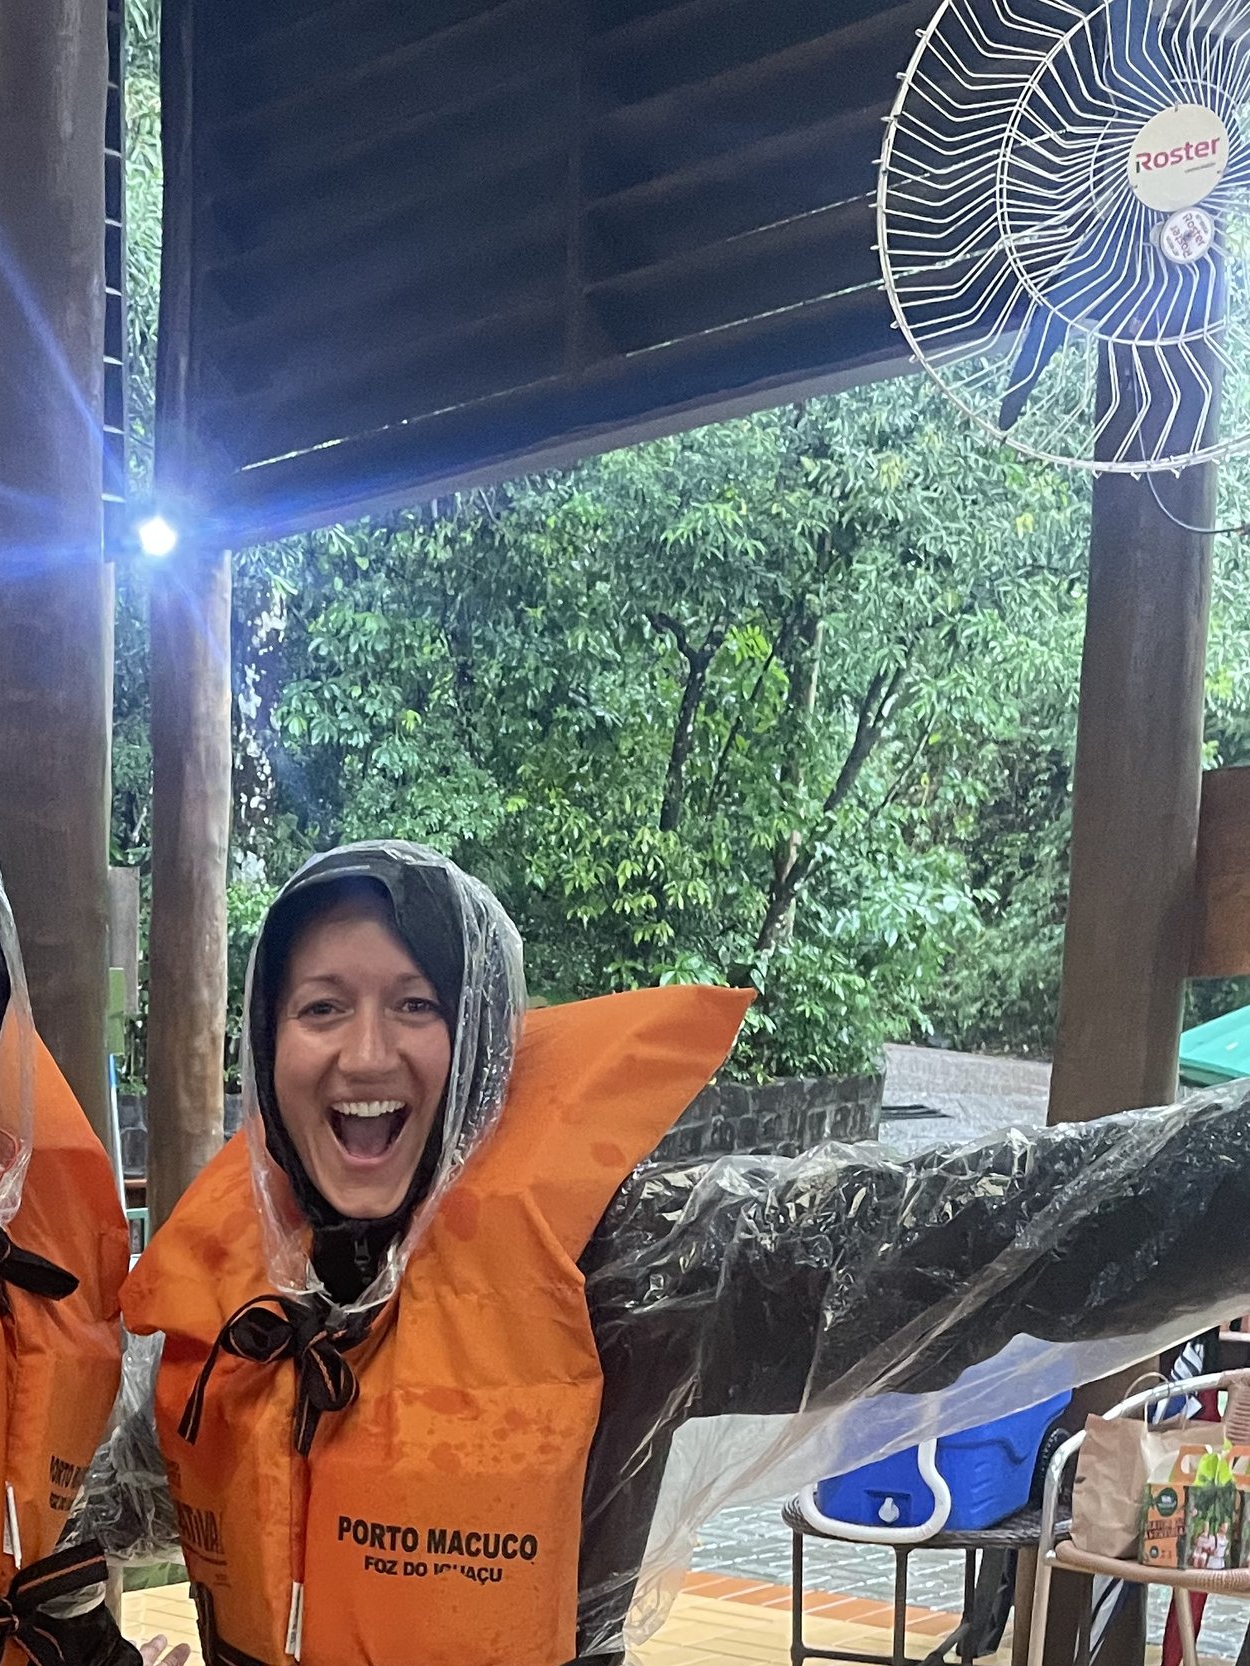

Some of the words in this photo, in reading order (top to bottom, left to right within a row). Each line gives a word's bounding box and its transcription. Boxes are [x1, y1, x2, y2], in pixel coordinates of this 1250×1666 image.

[1136, 137, 1221, 174] Roster
[1182, 213, 1206, 247] Roster
[337, 1516, 419, 1553] PORTO
[427, 1528, 538, 1561] MACUCO
[364, 1555, 399, 1576] FOZ
[403, 1561, 428, 1577] DO
